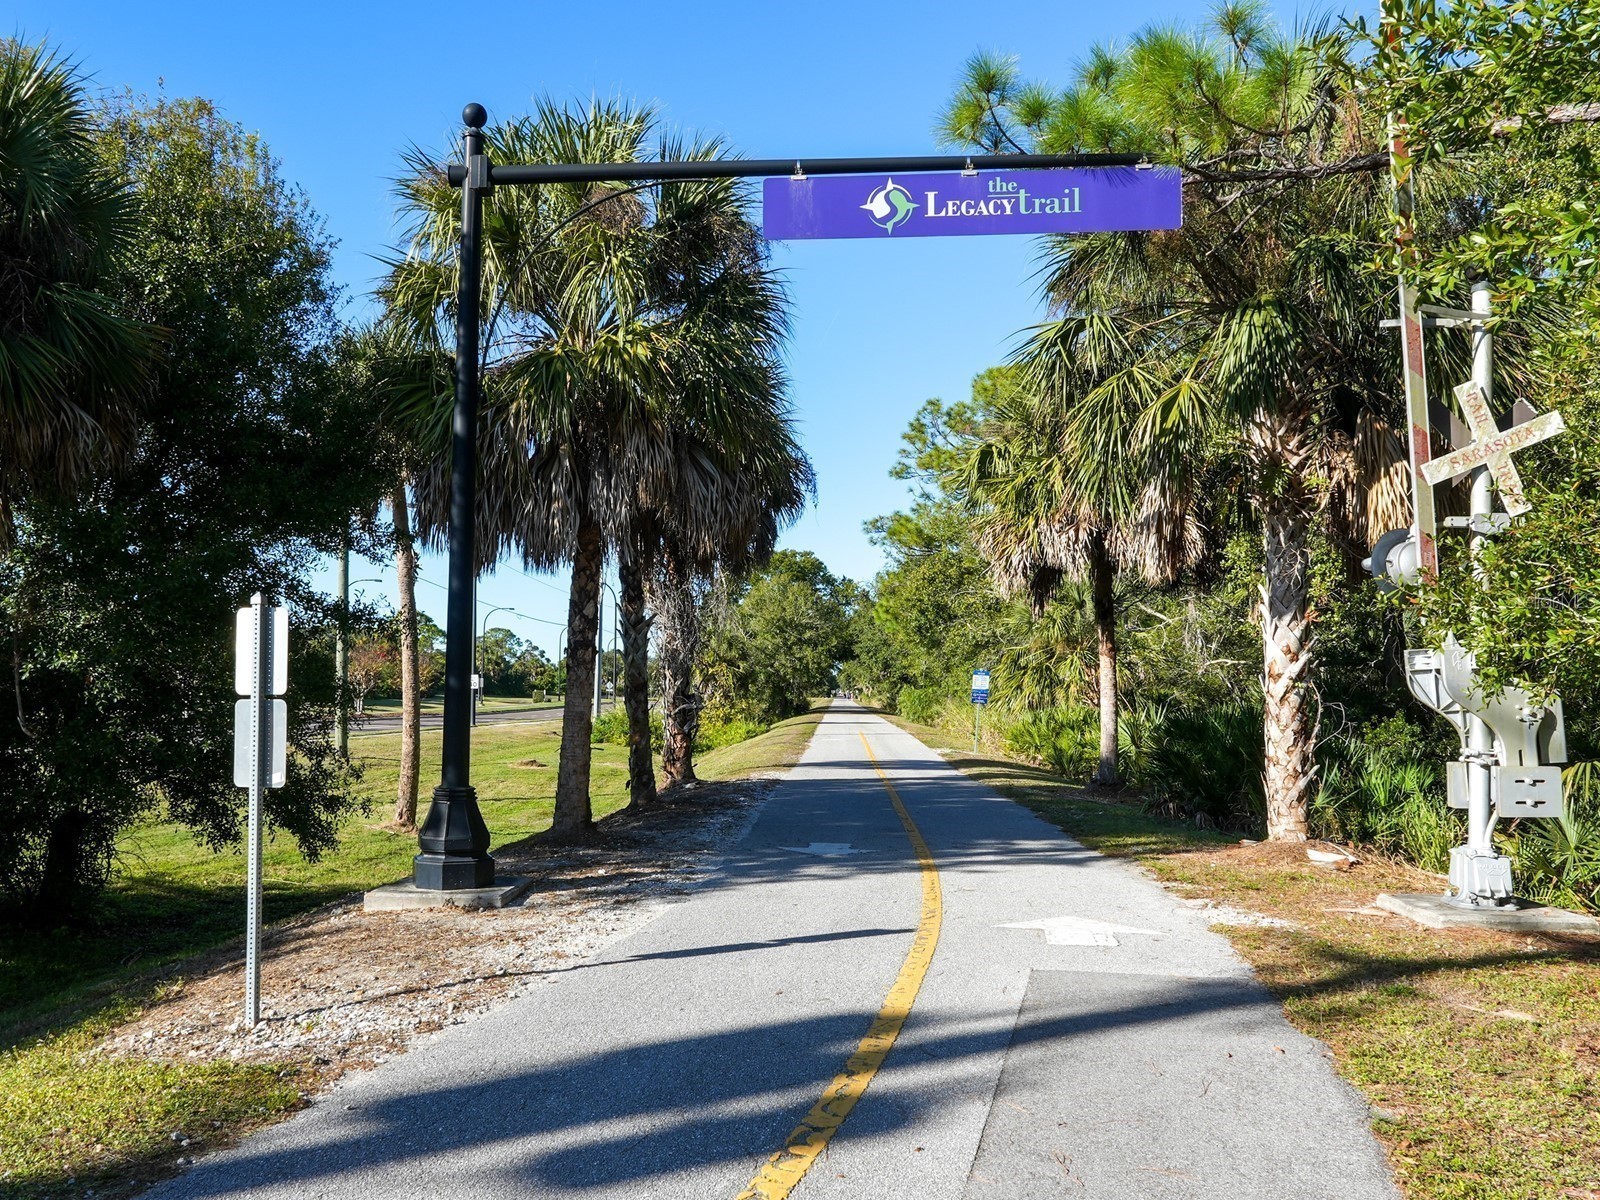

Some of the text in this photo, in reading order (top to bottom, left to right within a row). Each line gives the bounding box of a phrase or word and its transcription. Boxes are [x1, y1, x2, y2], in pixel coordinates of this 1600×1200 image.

[988, 177, 1018, 193] the
[924, 187, 1082, 217] LEGACY trail
[1466, 391, 1489, 427] RAIL
[1450, 427, 1536, 469] SARASOTA
